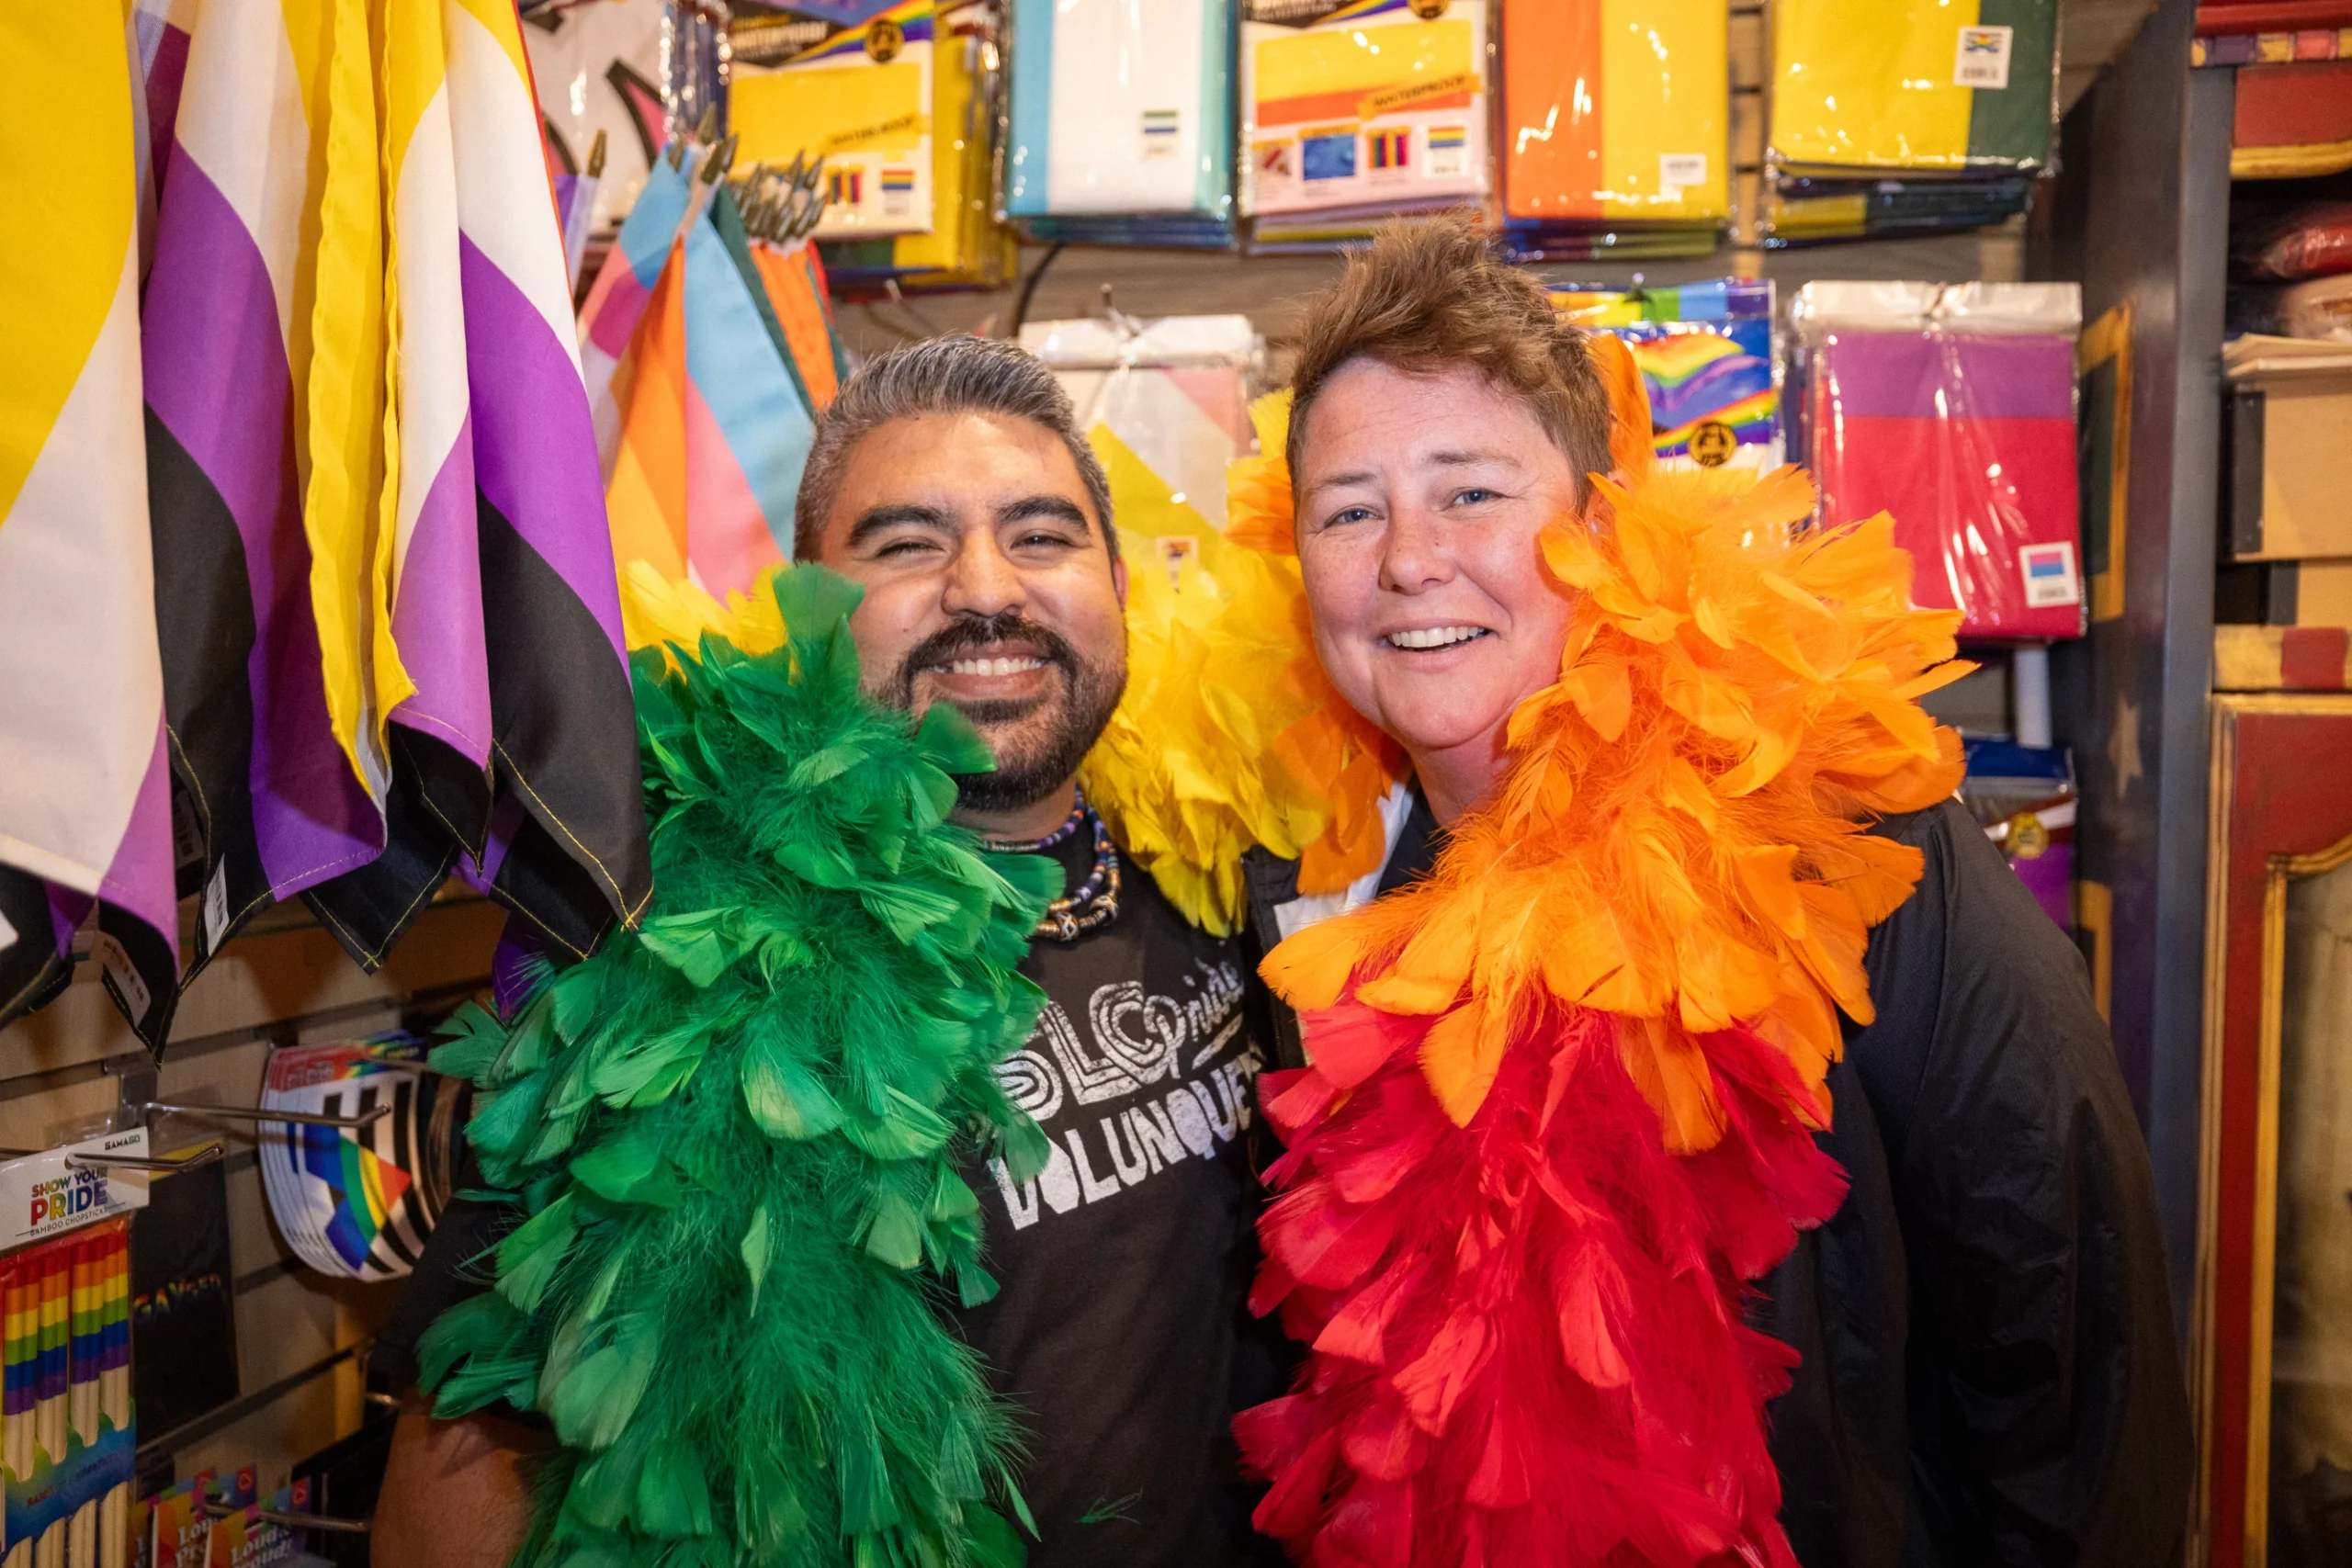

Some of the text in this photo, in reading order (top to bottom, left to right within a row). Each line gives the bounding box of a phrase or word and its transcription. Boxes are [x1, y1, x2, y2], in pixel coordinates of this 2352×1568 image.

[105, 1134, 141, 1151] GAMAGO
[31, 1168, 108, 1199] SHOW YOUR
[30, 1179, 108, 1226] PRIDE
[29, 1206, 108, 1237] BAMBOO CHOPSTICKS
